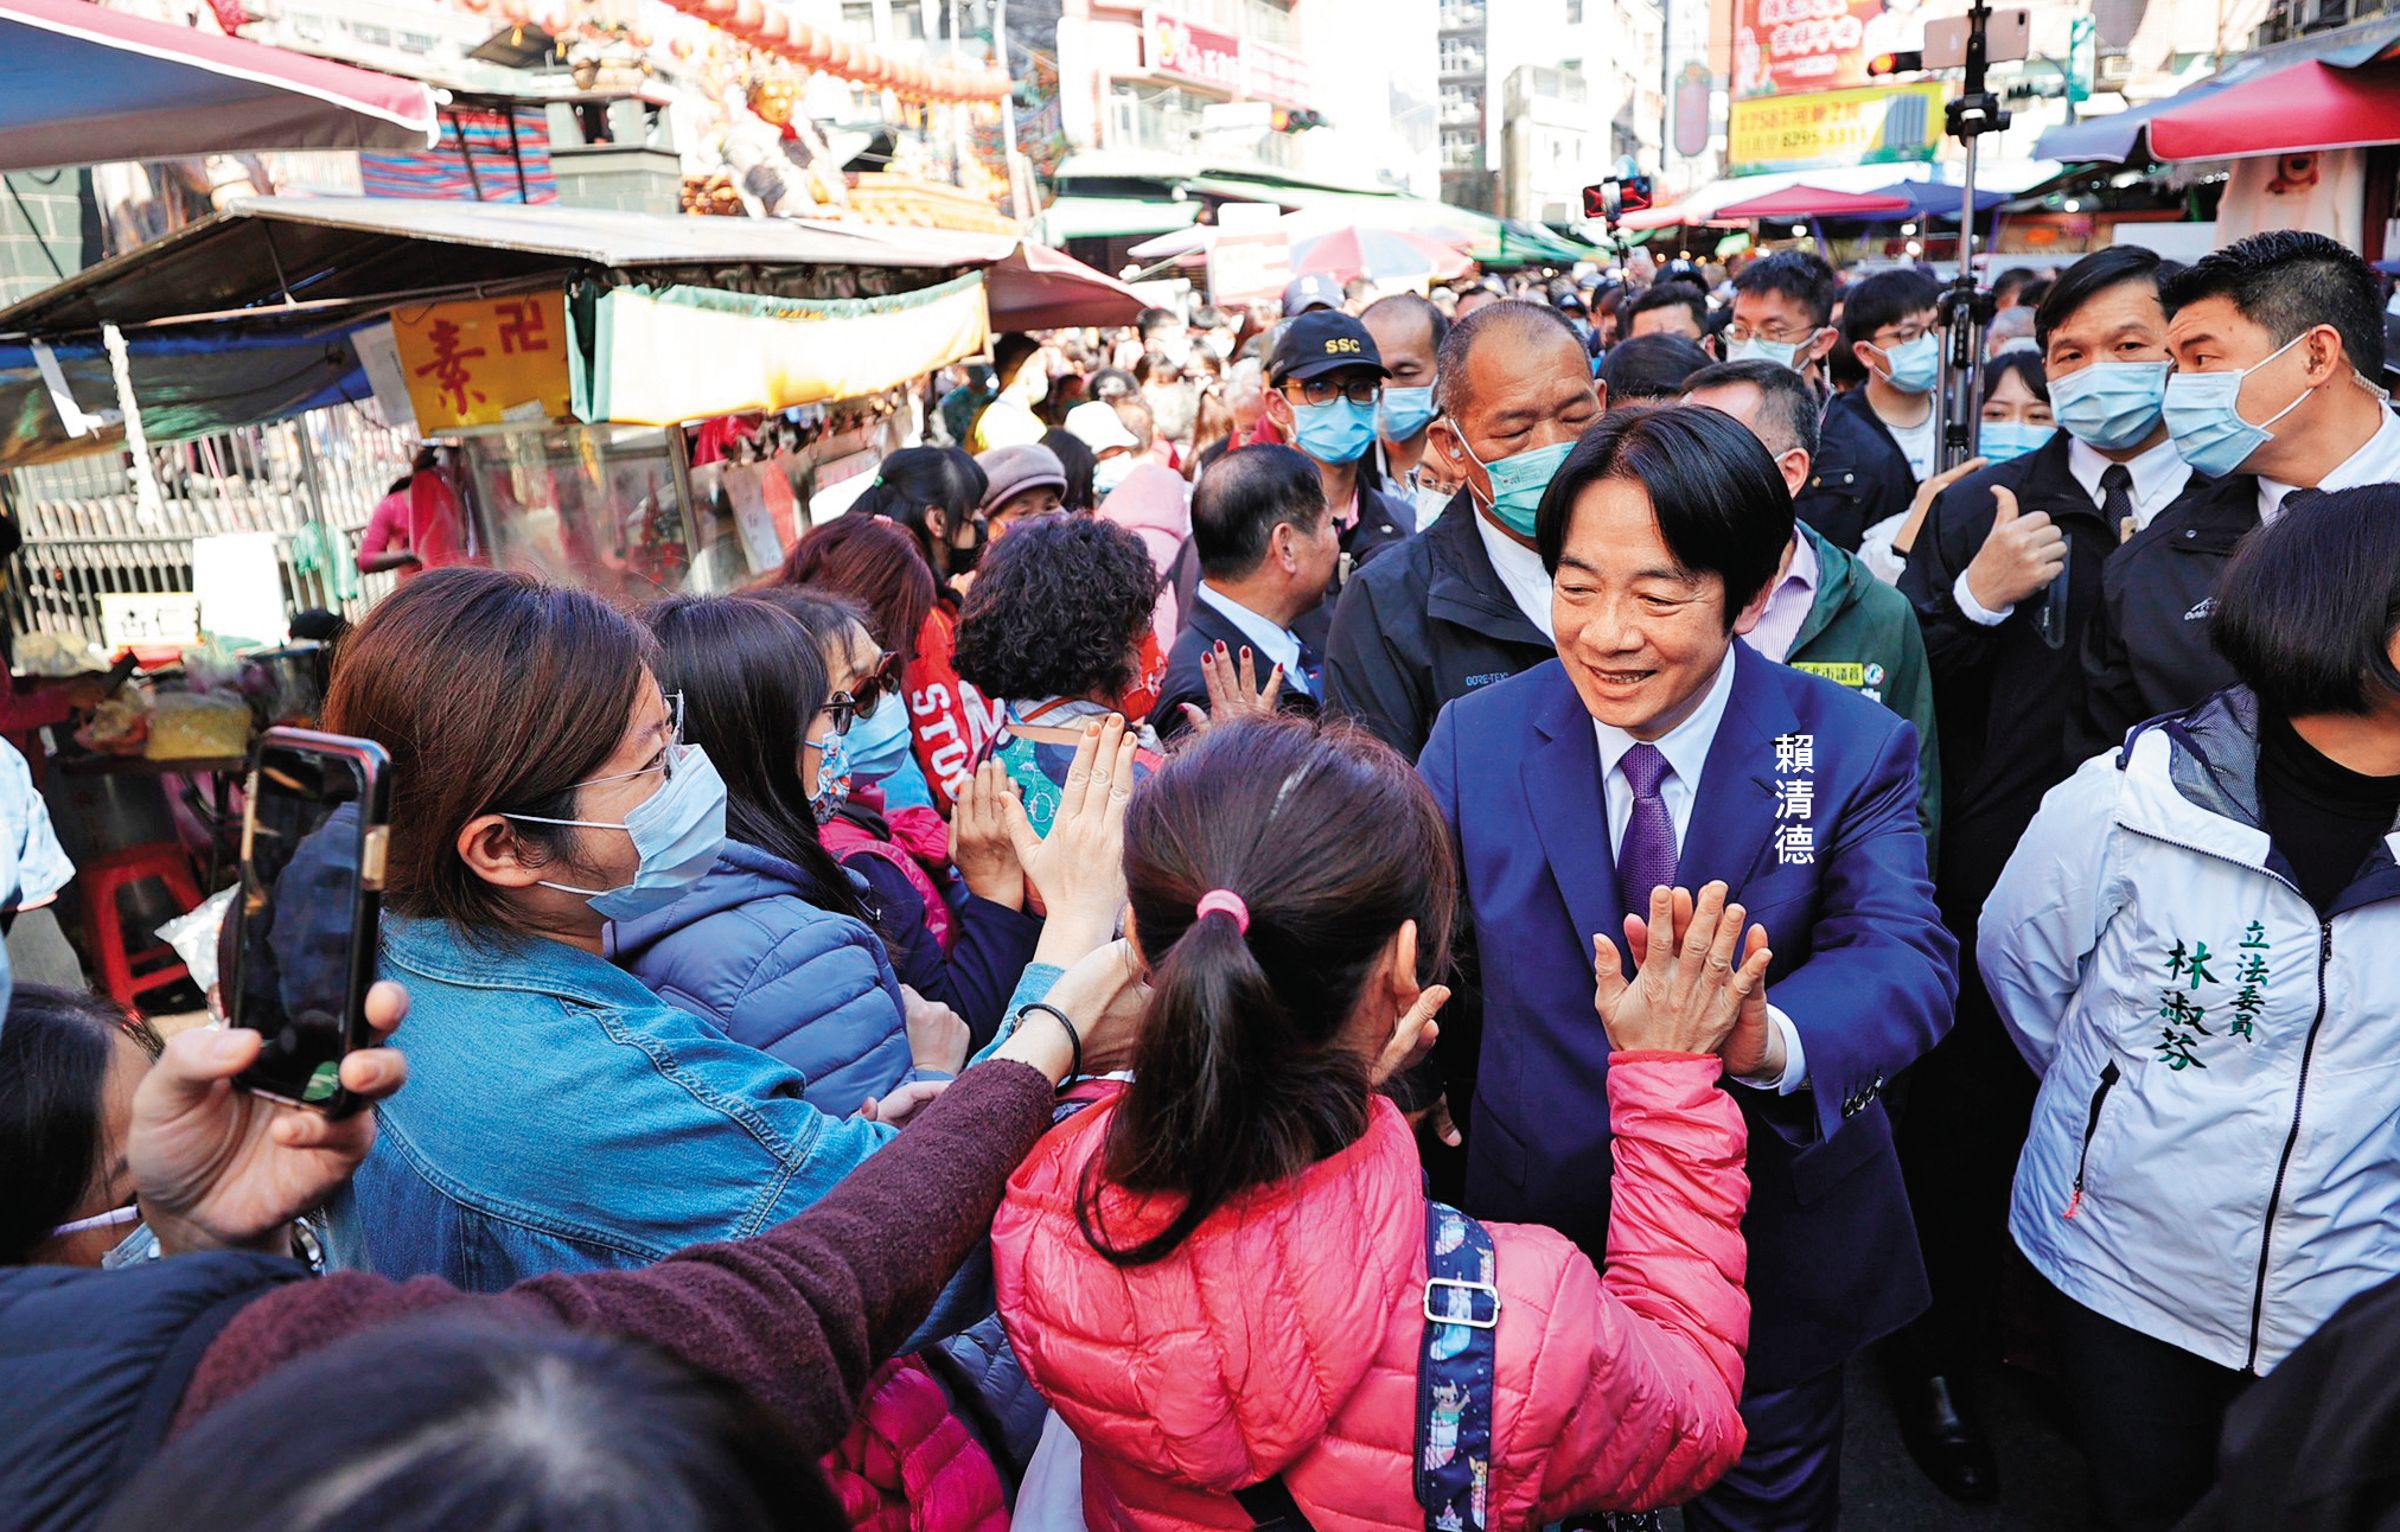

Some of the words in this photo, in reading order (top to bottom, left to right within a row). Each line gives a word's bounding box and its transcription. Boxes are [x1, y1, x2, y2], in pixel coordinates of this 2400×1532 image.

[415, 318, 486, 416] 素
[1325, 338, 1361, 354] SSC
[2153, 938, 2220, 1071] 林淑芬
[2228, 919, 2271, 1043] 立法委員
